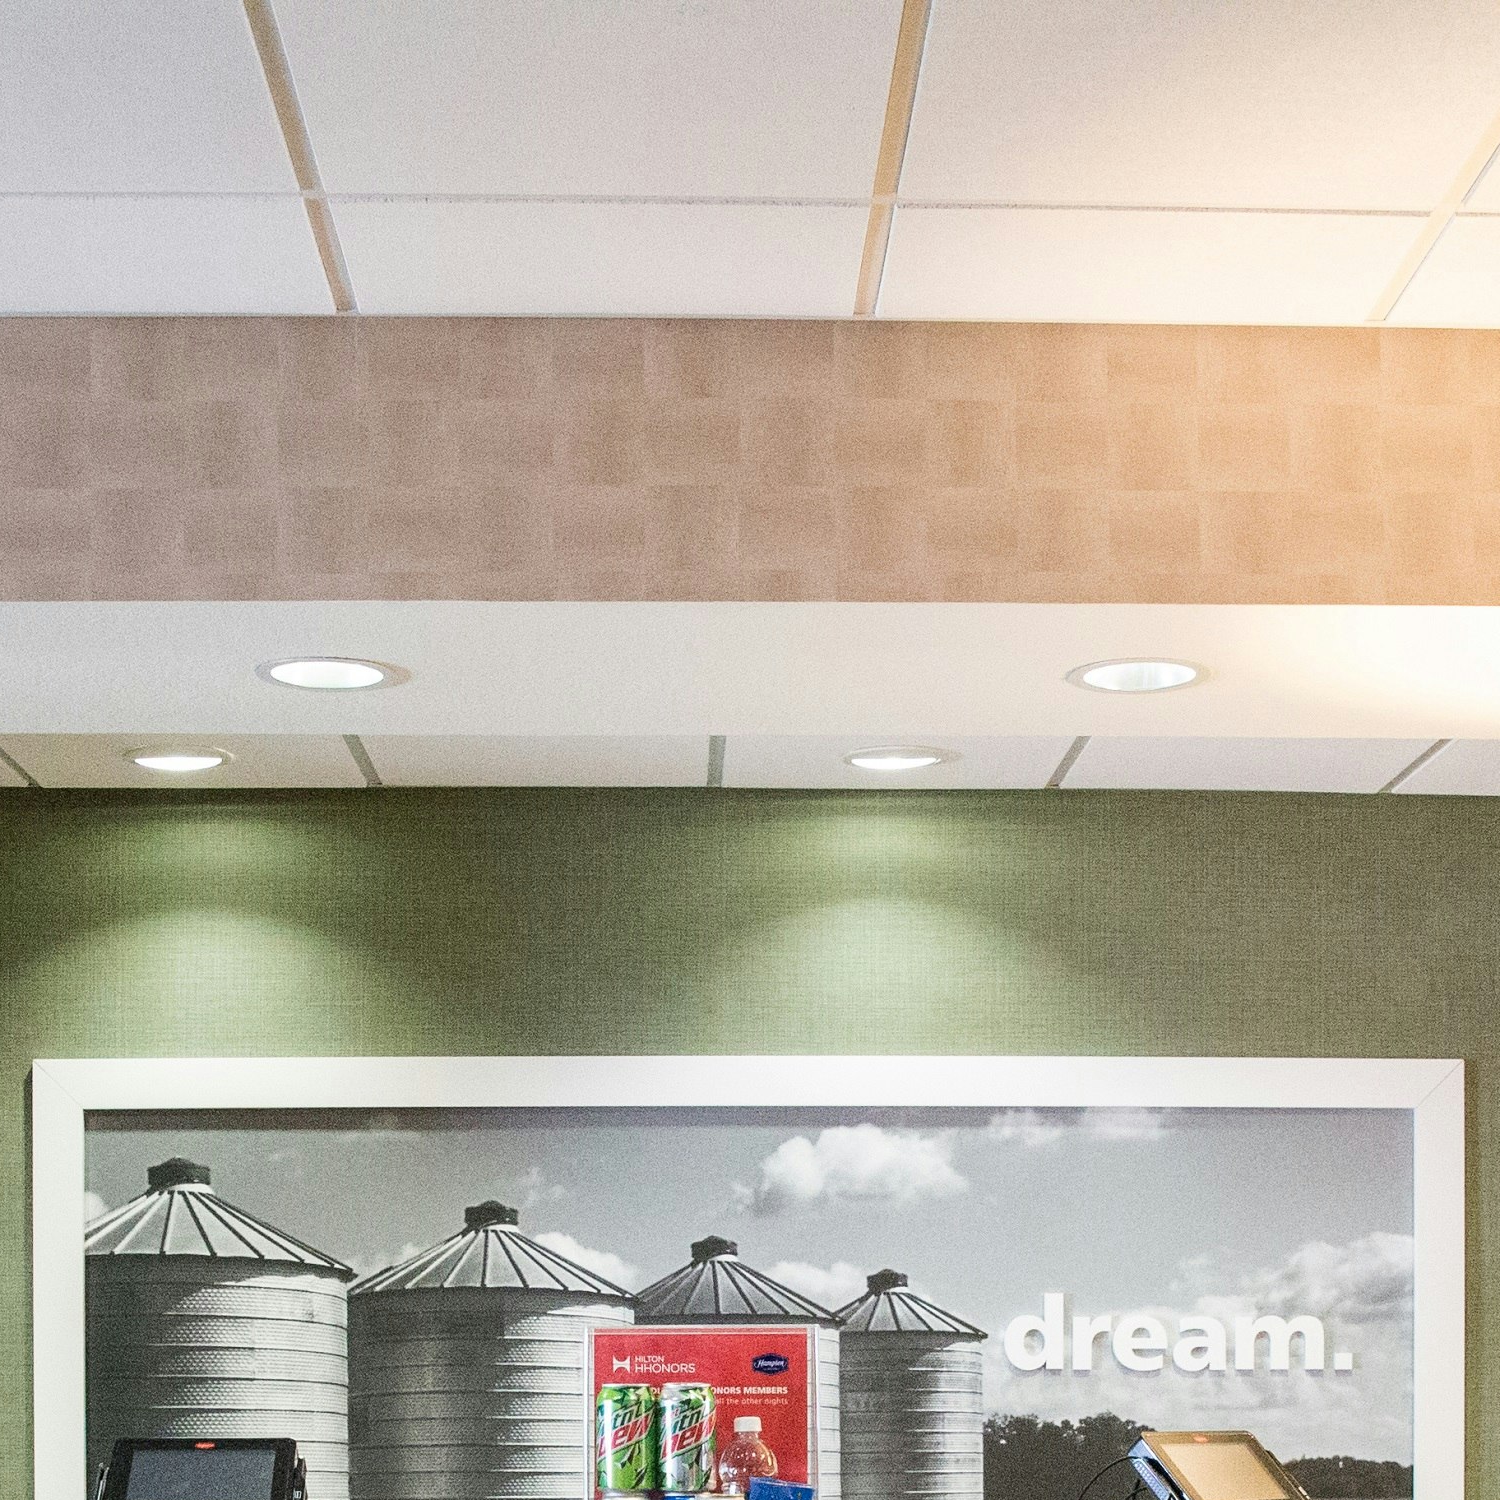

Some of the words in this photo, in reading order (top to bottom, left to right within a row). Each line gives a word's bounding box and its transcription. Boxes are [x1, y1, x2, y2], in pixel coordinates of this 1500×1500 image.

[1003, 1292, 1353, 1371] dream.
[634, 1363, 696, 1373] HHONORS
[754, 1359, 787, 1368] Hampton
[711, 1387, 741, 1395] ONORS
[743, 1387, 788, 1395] MEMBERS
